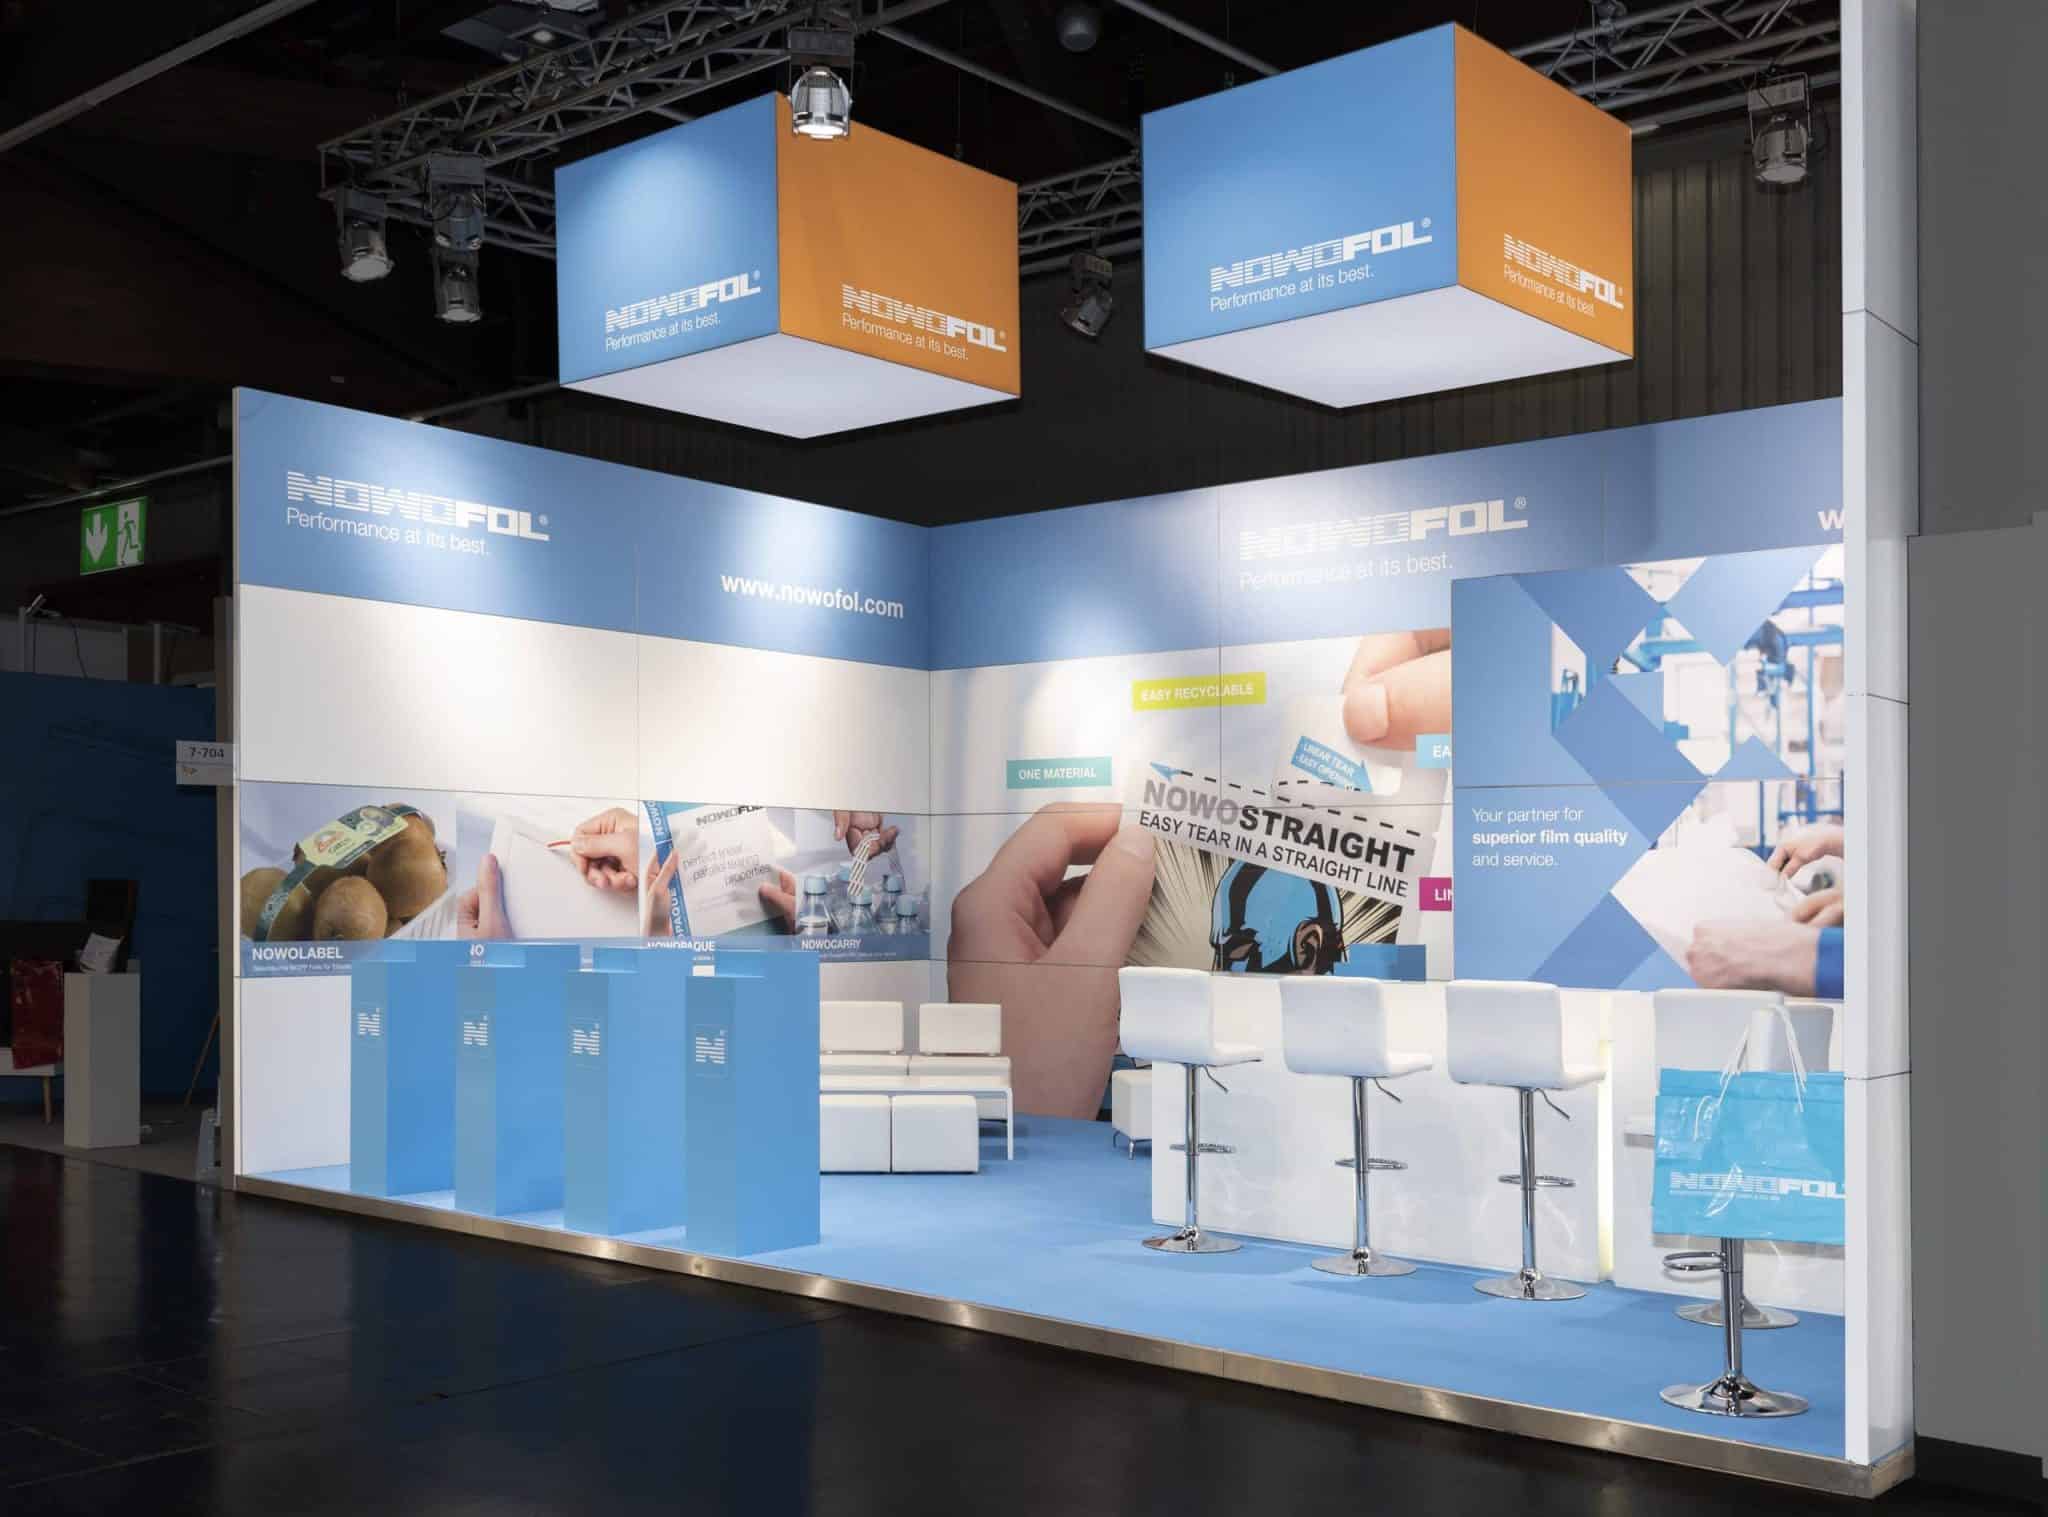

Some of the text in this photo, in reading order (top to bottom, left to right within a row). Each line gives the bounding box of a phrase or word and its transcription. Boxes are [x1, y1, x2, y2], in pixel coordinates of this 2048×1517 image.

[1210, 221, 1432, 292] NOWOFOL
[1503, 233, 1625, 310] NOWOFOL
[605, 272, 761, 333] NOWOFOL
[1210, 264, 1375, 312] Performance at its best.
[1503, 264, 1556, 300] Performance
[1556, 291, 1566, 305] at
[605, 311, 721, 352] Performance at its best.
[842, 284, 1007, 352] NOWOFOL
[842, 312, 969, 361] Performance at its best.
[287, 471, 550, 541] NOWOFOL
[286, 507, 490, 556] Performance at its best.
[1239, 499, 1529, 561] NOWOFOL
[1358, 560, 1375, 578] at
[1379, 555, 1401, 577] its
[1407, 551, 1454, 574] best.
[720, 574, 904, 619] www.nowofol.com
[1142, 681, 1255, 702] EASY RECYCLABLE
[1018, 766, 1097, 780] ONE MATERIAL
[1143, 779, 1416, 873] NOWOSTRAIGHT
[1472, 806, 1584, 825] Your partner for
[1472, 827, 1629, 848] superior film quality
[1139, 809, 1409, 898] EASY TEAR IN A STRAIGHT LINE
[1472, 853, 1499, 867] and
[252, 947, 344, 961] NOWOLABEL
[801, 939, 863, 951] NOWOCARRY
